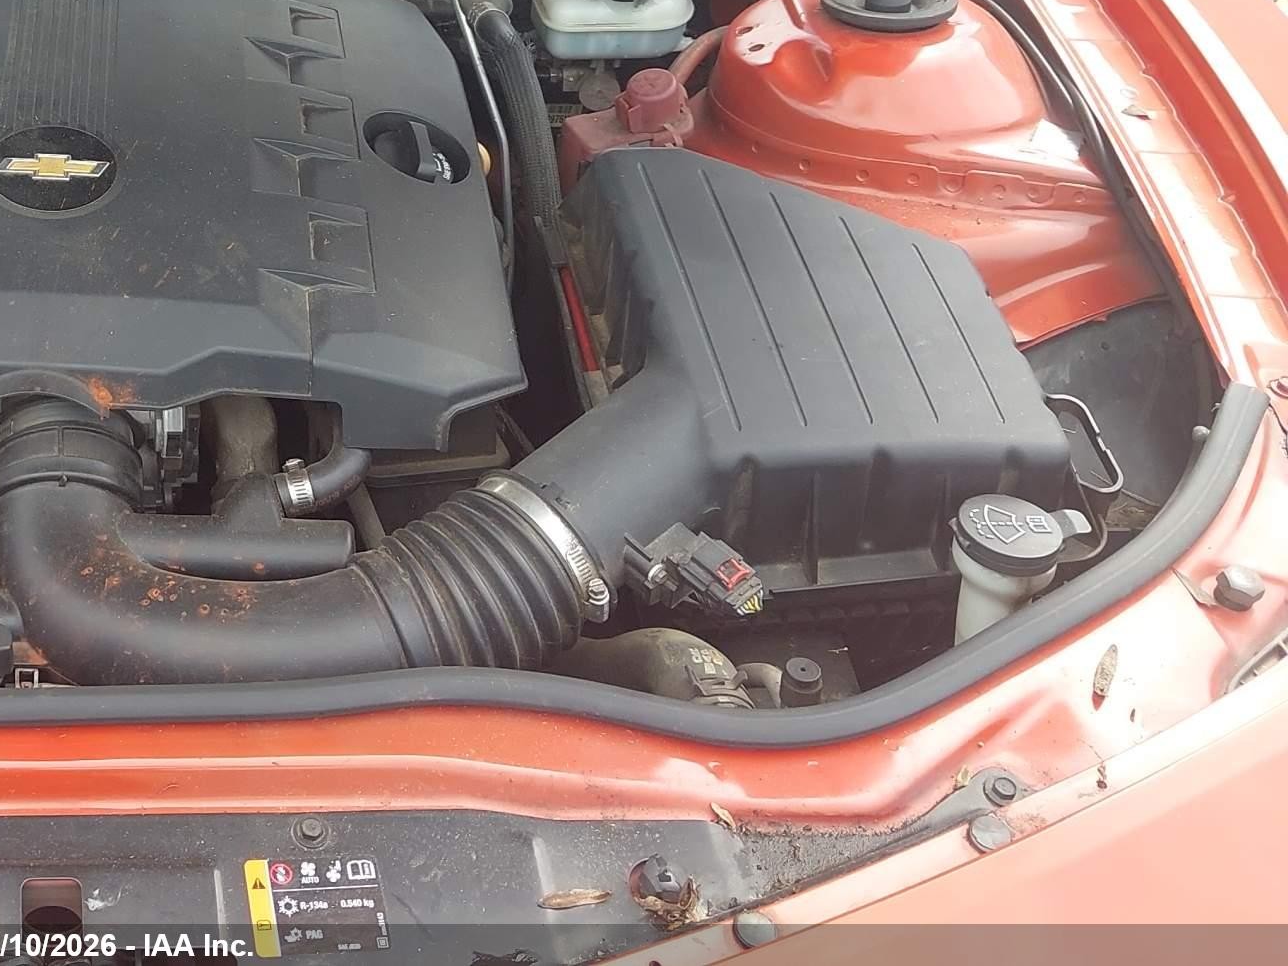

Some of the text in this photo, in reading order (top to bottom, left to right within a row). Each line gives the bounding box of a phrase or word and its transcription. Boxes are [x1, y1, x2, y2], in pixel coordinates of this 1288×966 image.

[301, 876, 319, 884] AUTO
[363, 898, 374, 909] kg
[305, 929, 324, 940] PAG
